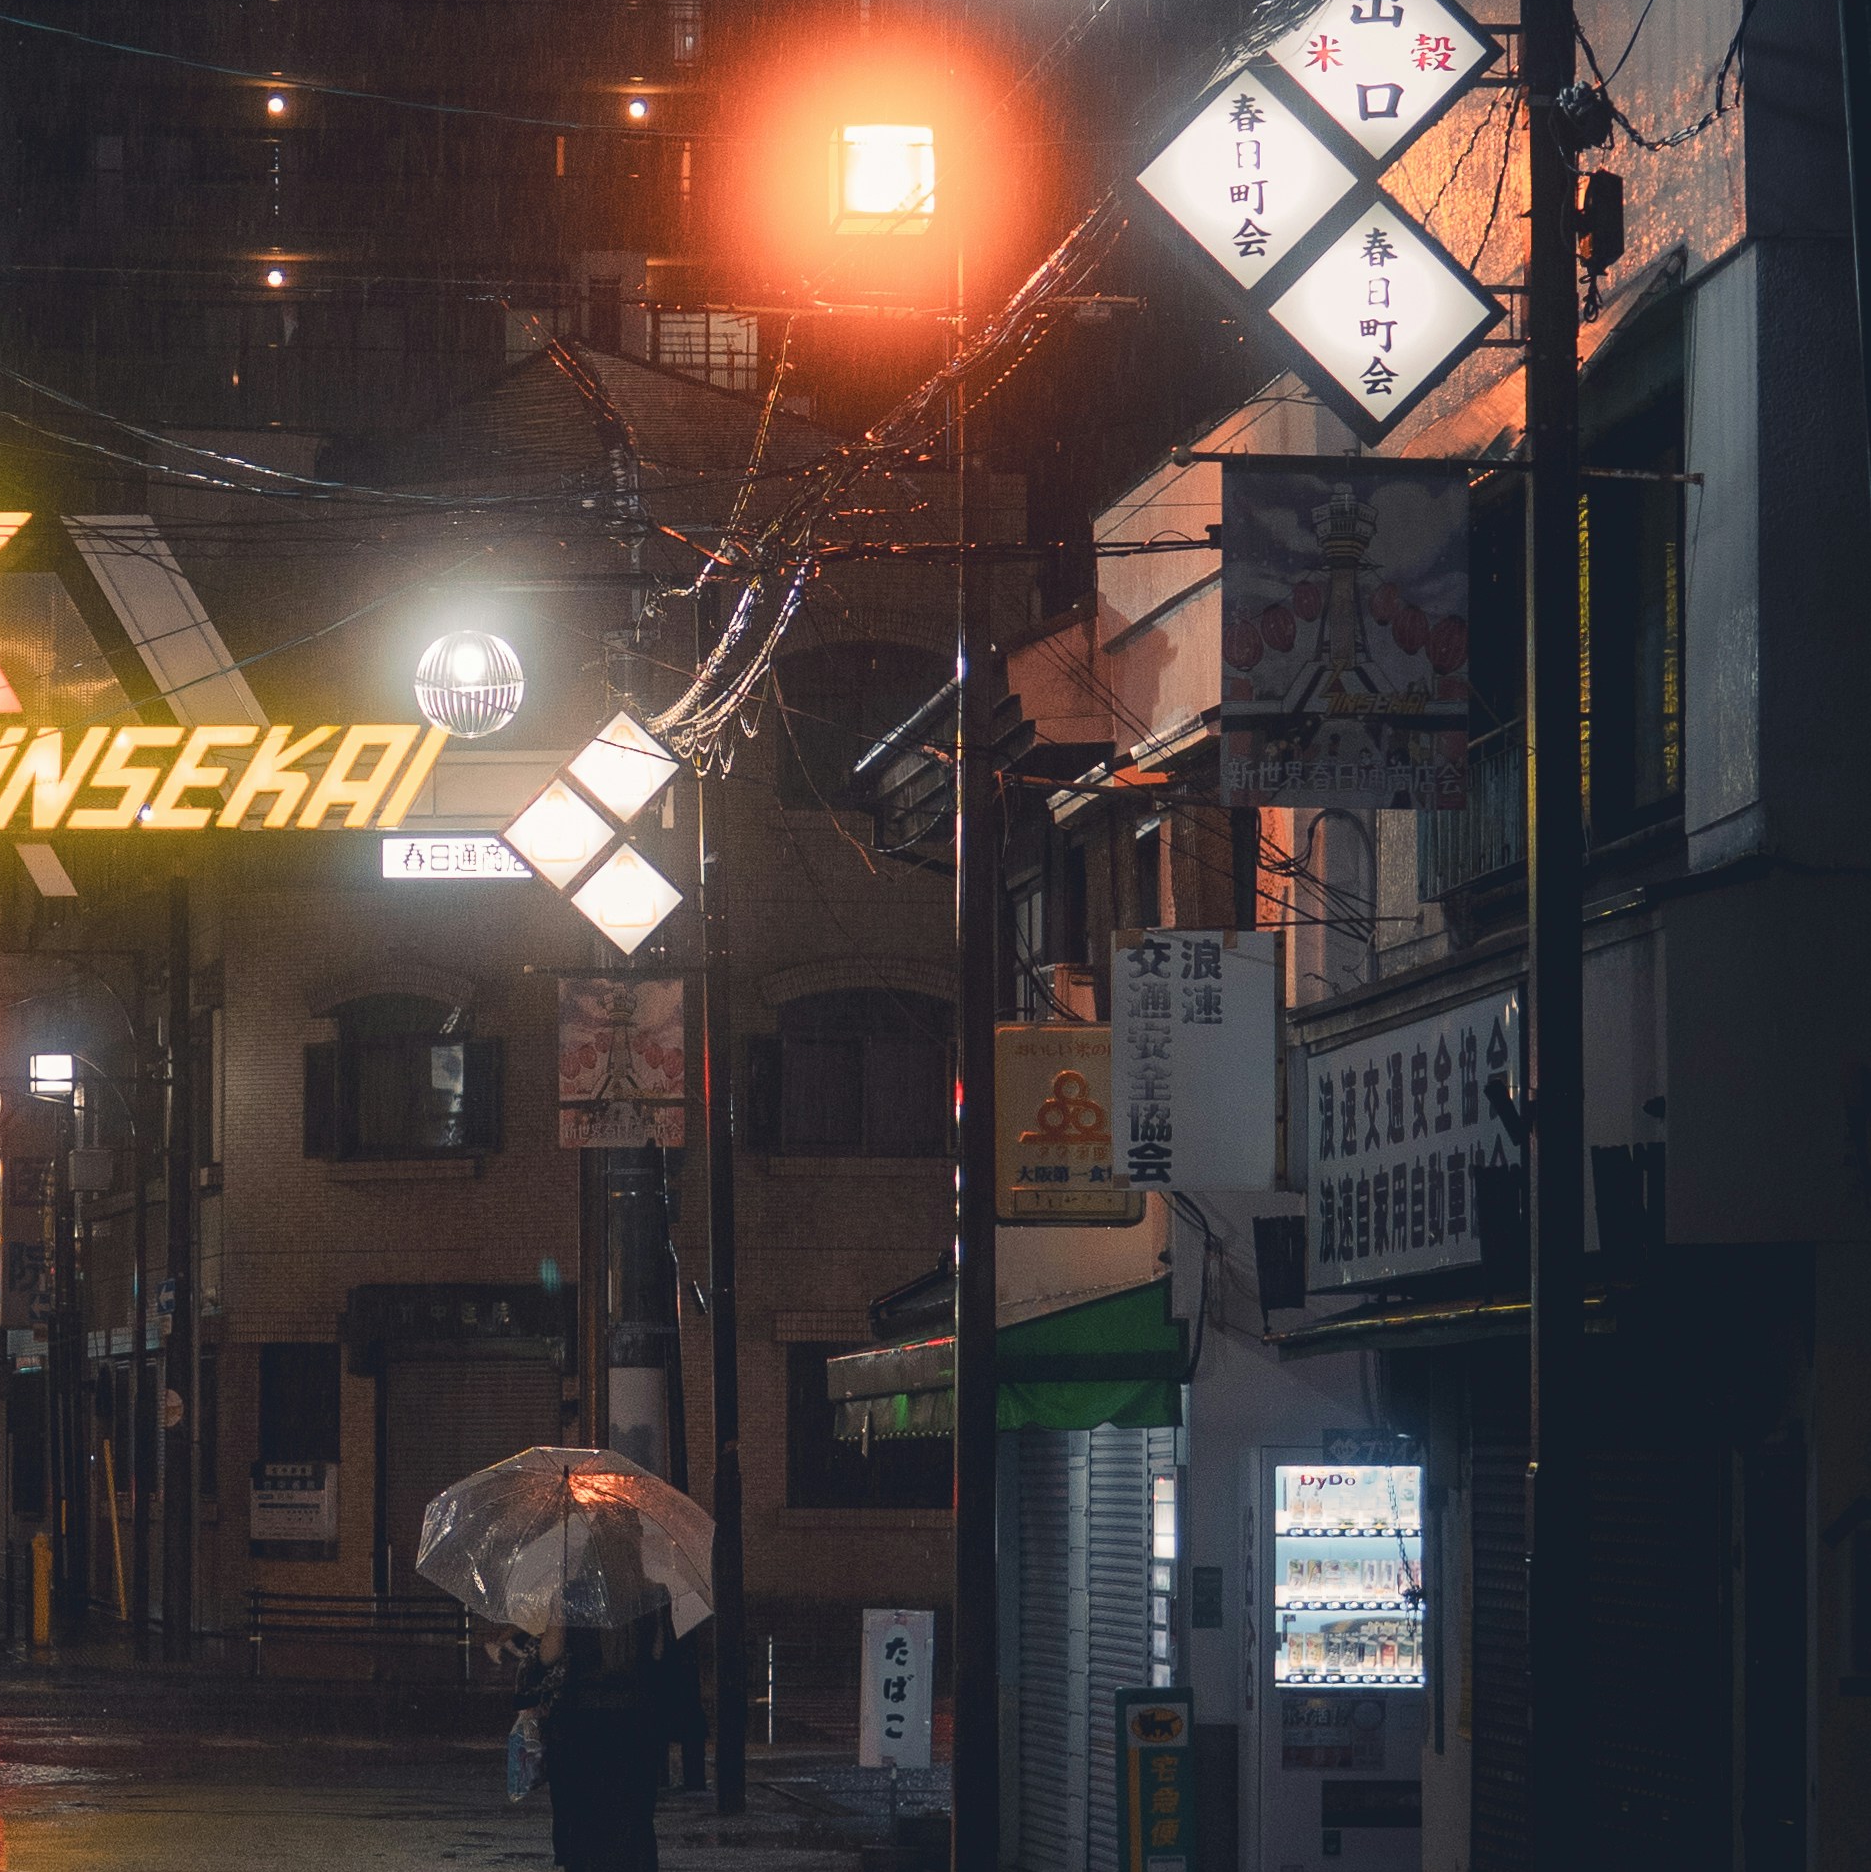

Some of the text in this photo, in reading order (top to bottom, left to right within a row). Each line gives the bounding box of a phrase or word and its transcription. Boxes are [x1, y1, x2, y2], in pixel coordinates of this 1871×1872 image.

[1228, 93, 1272, 258] 春日町会
[1359, 227, 1400, 397] 春日町会
[1180, 939, 1223, 1025] 浪速
[1127, 938, 1172, 1184] 交通安全協会
[1299, 1473, 1357, 1490] DyDo
[882, 1635, 913, 1741] たばこ
[1150, 1753, 1181, 1848] 宅急便
